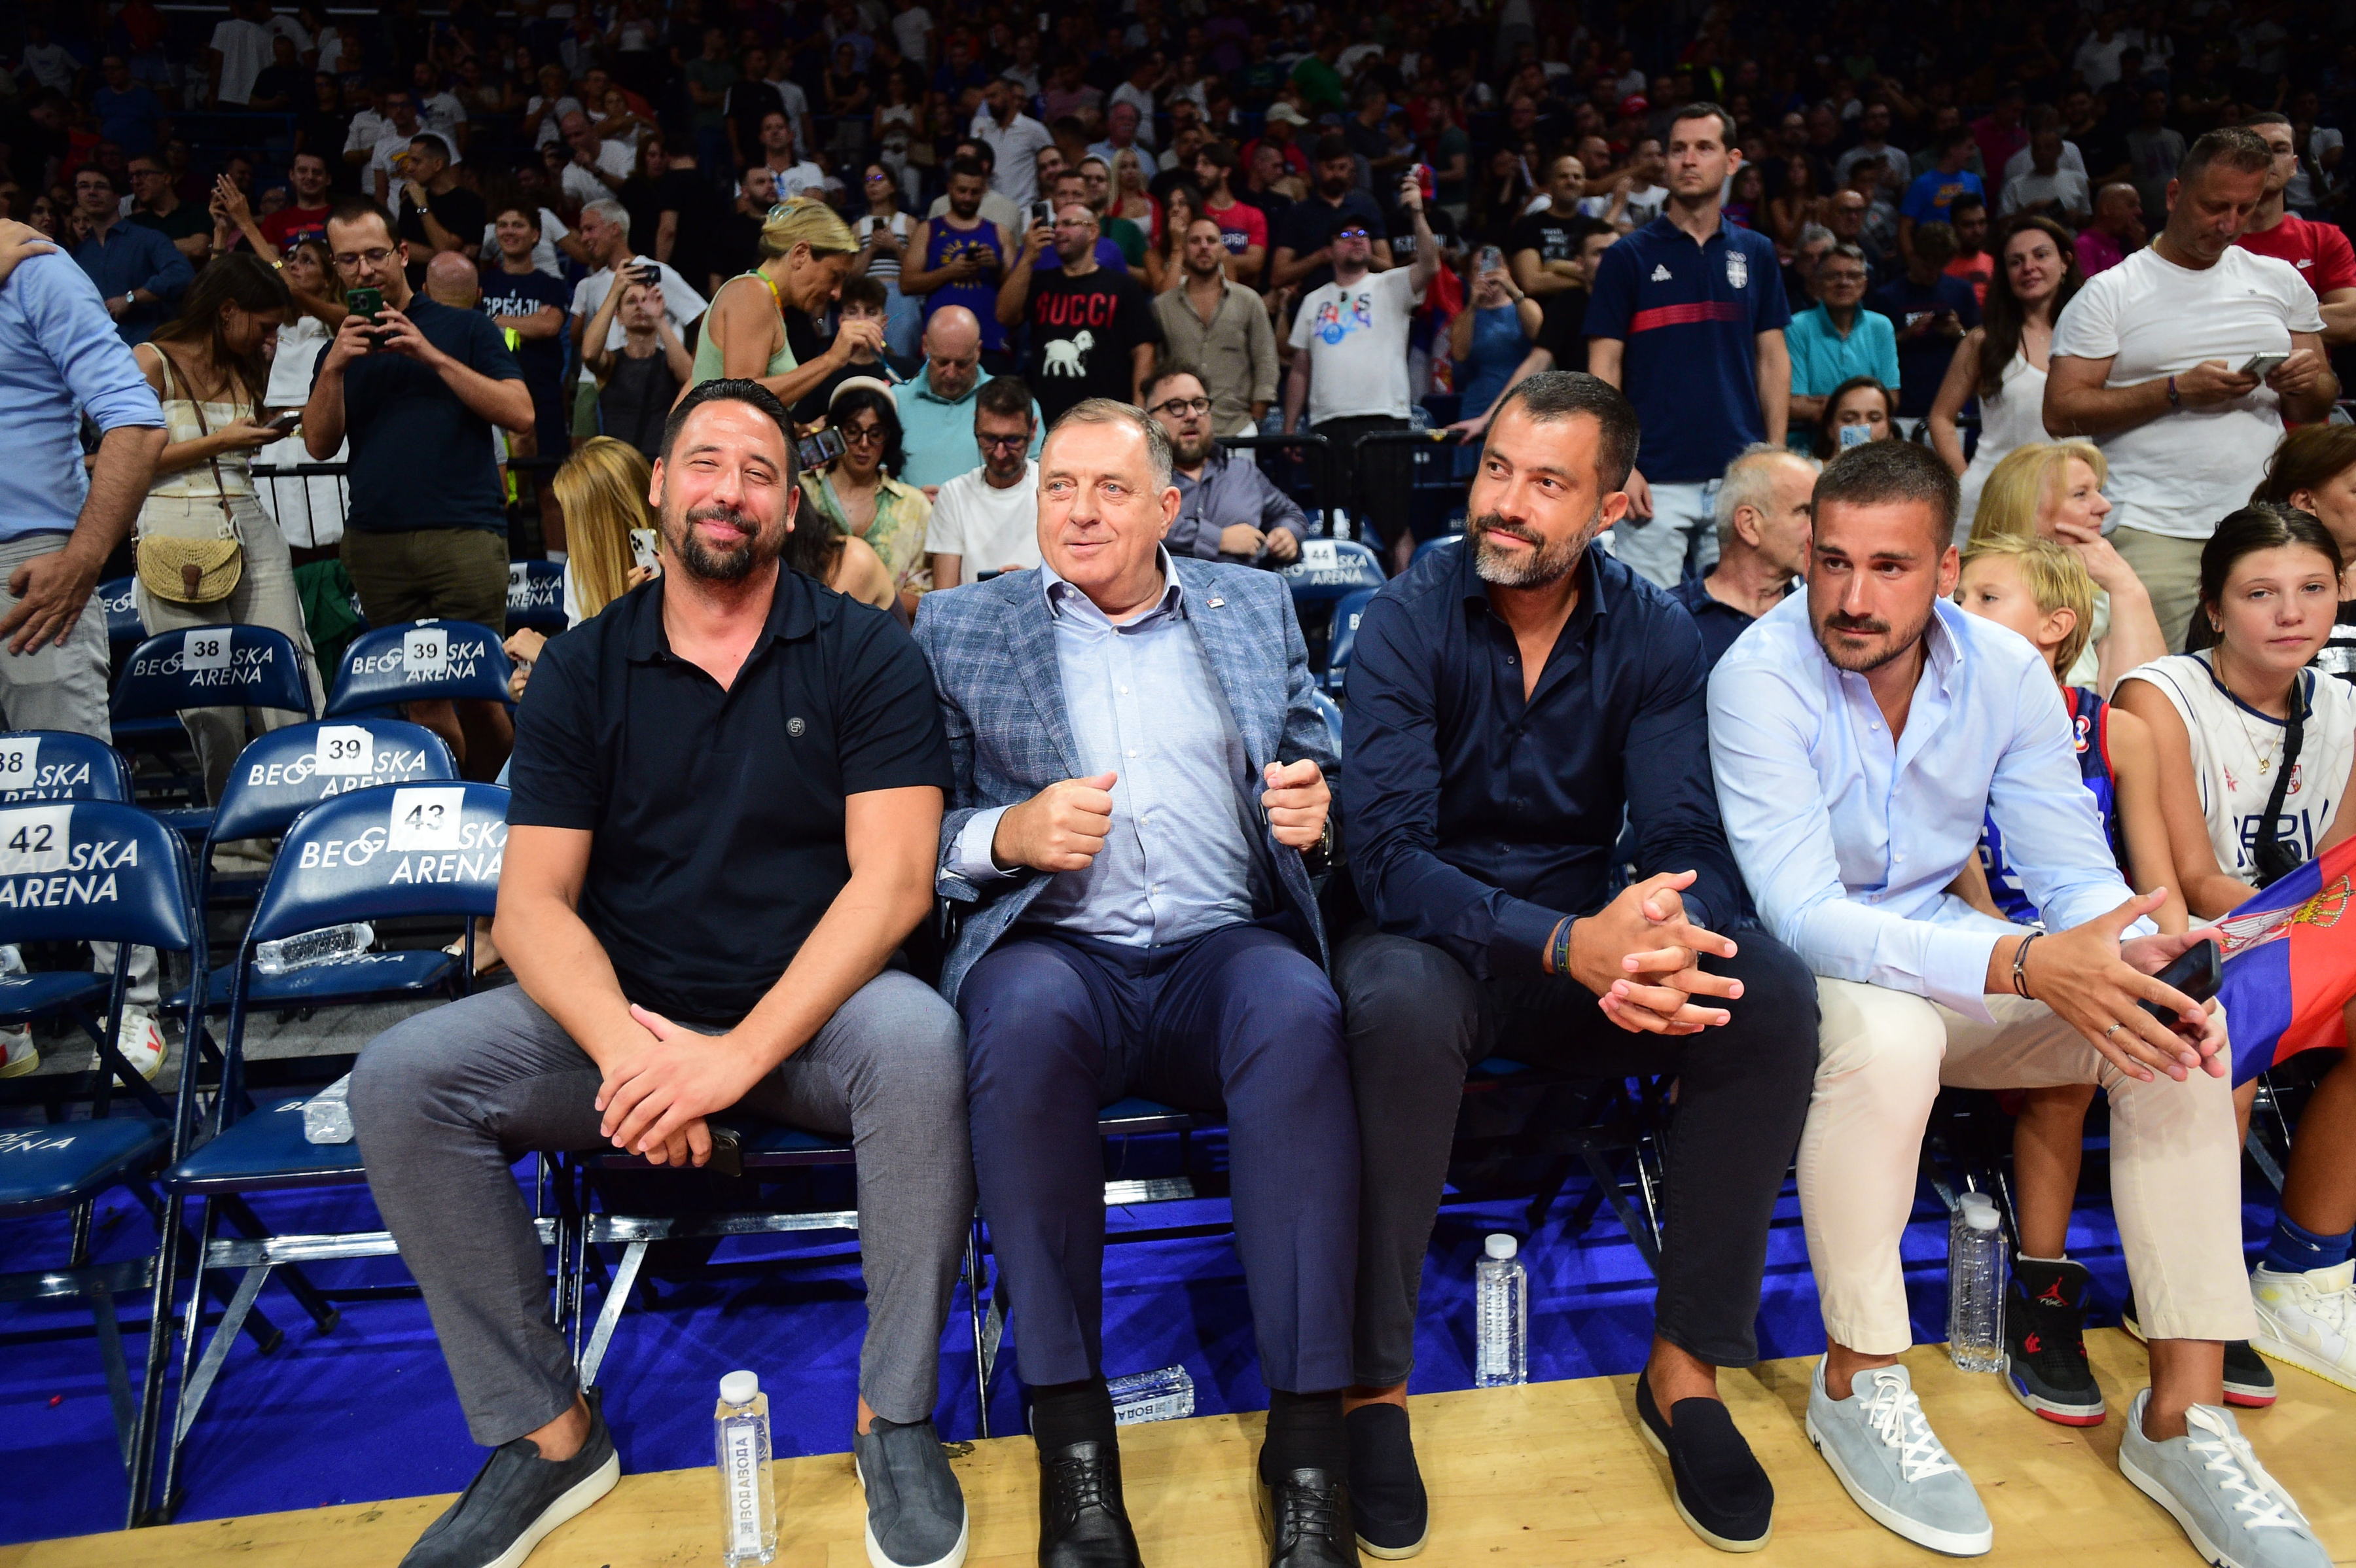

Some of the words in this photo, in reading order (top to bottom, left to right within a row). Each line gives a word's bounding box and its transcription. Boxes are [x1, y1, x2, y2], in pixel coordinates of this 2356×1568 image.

[1035, 291, 1118, 329] GUCCI
[1310, 568, 1363, 586] ARENA
[506, 590, 554, 607] RENA
[134, 646, 273, 676] BEOGSKA
[194, 641, 219, 658] 38
[351, 640, 485, 675] BEOGSKA
[413, 643, 438, 659] 39
[190, 666, 261, 686] ARENA
[406, 660, 476, 683] ARENA
[329, 739, 361, 759] 39
[0, 752, 23, 773] 8
[248, 749, 426, 786] BEOGSKA
[404, 804, 445, 830] 43
[9, 824, 53, 853] 42
[389, 851, 501, 884] ARENA
[0, 873, 118, 908] ARENA
[736, 1437, 753, 1520] ВОДАВОДА
